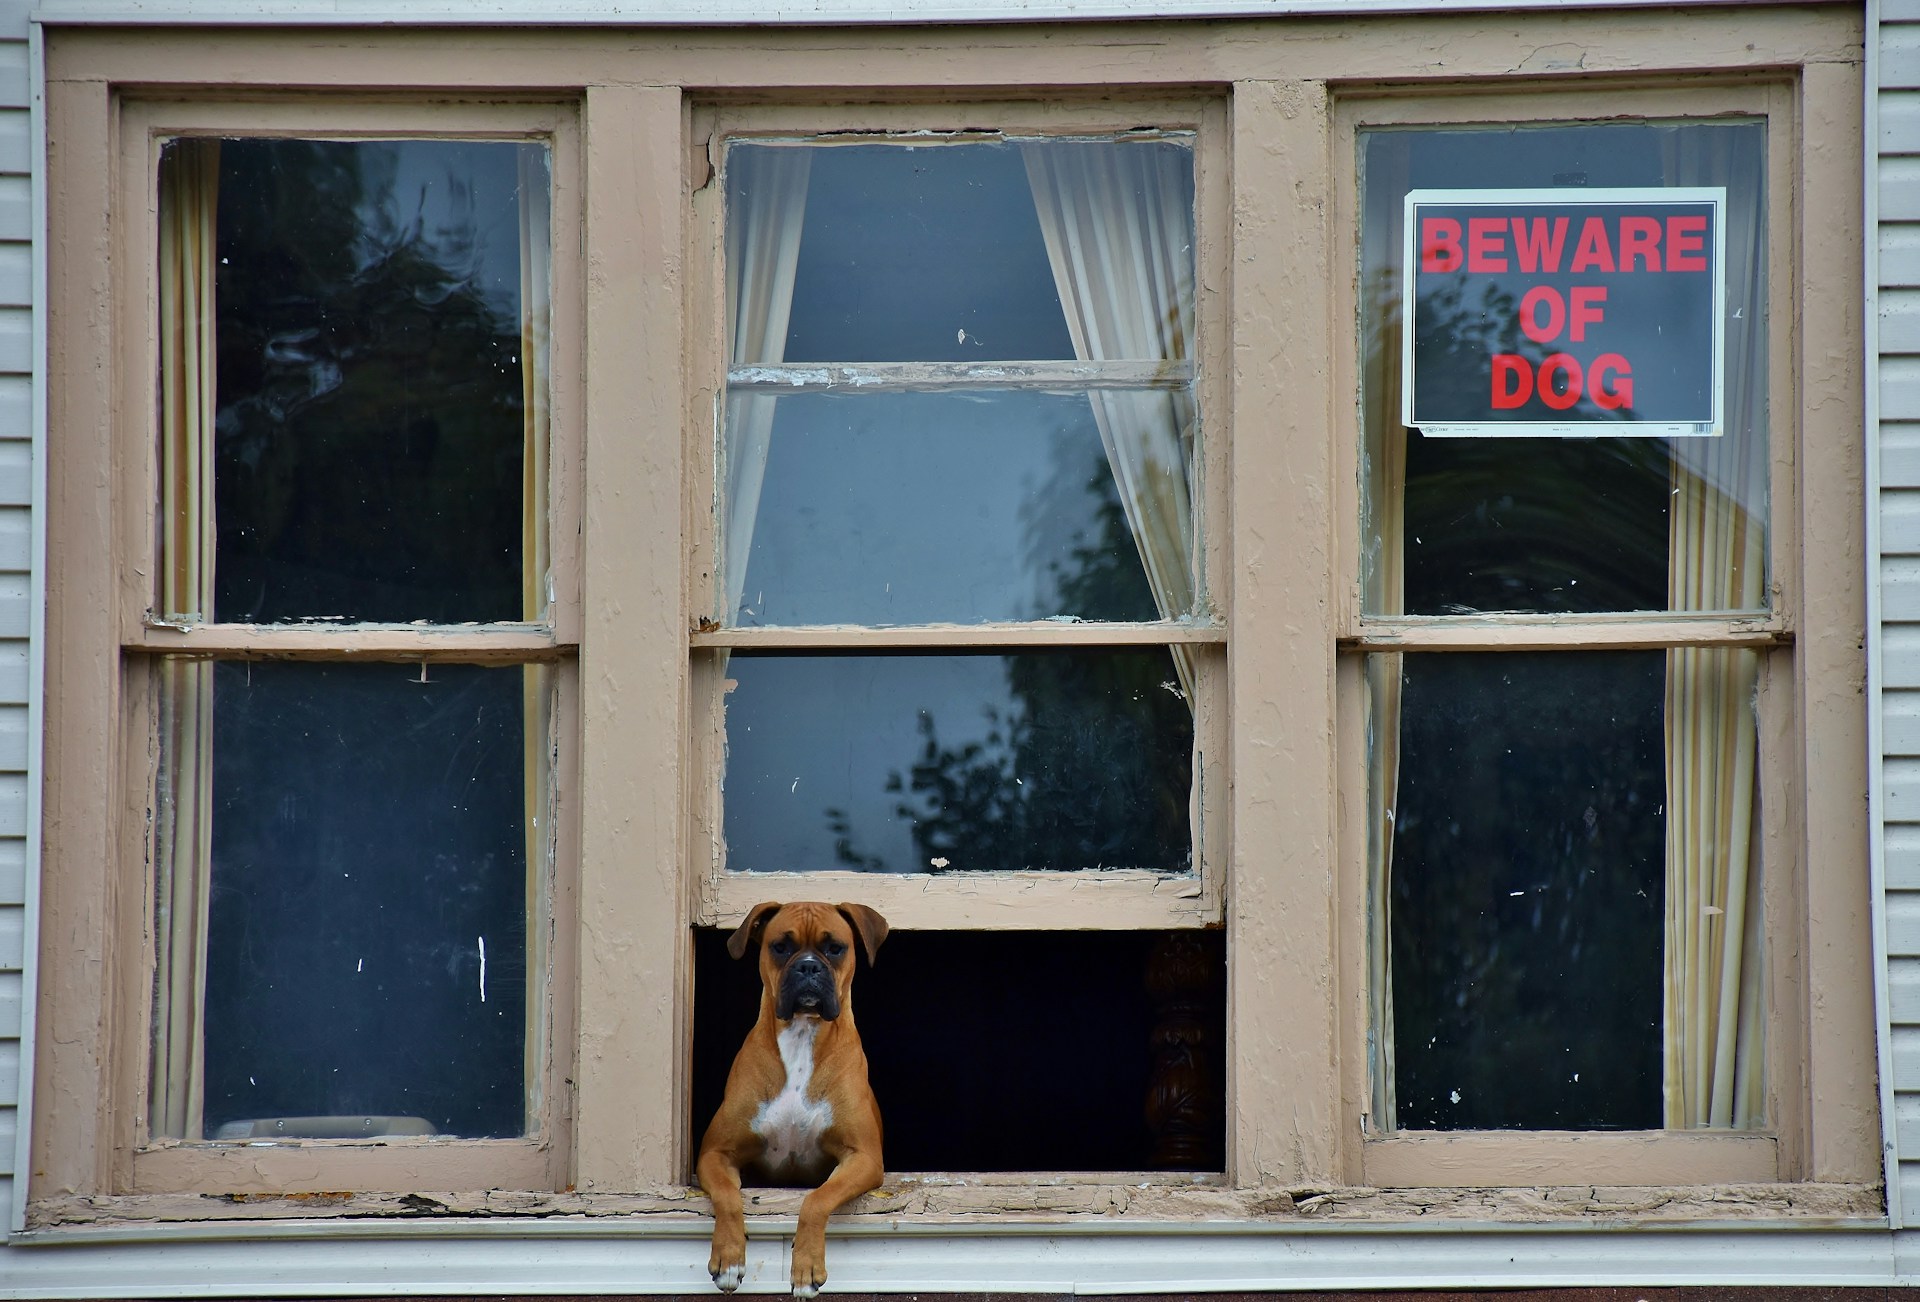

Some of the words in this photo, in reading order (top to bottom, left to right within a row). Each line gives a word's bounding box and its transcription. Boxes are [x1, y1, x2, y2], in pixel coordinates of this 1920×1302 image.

[1422, 216, 1707, 273] BEWARE
[1519, 285, 1608, 343] OF
[1491, 353, 1633, 411] DOG
